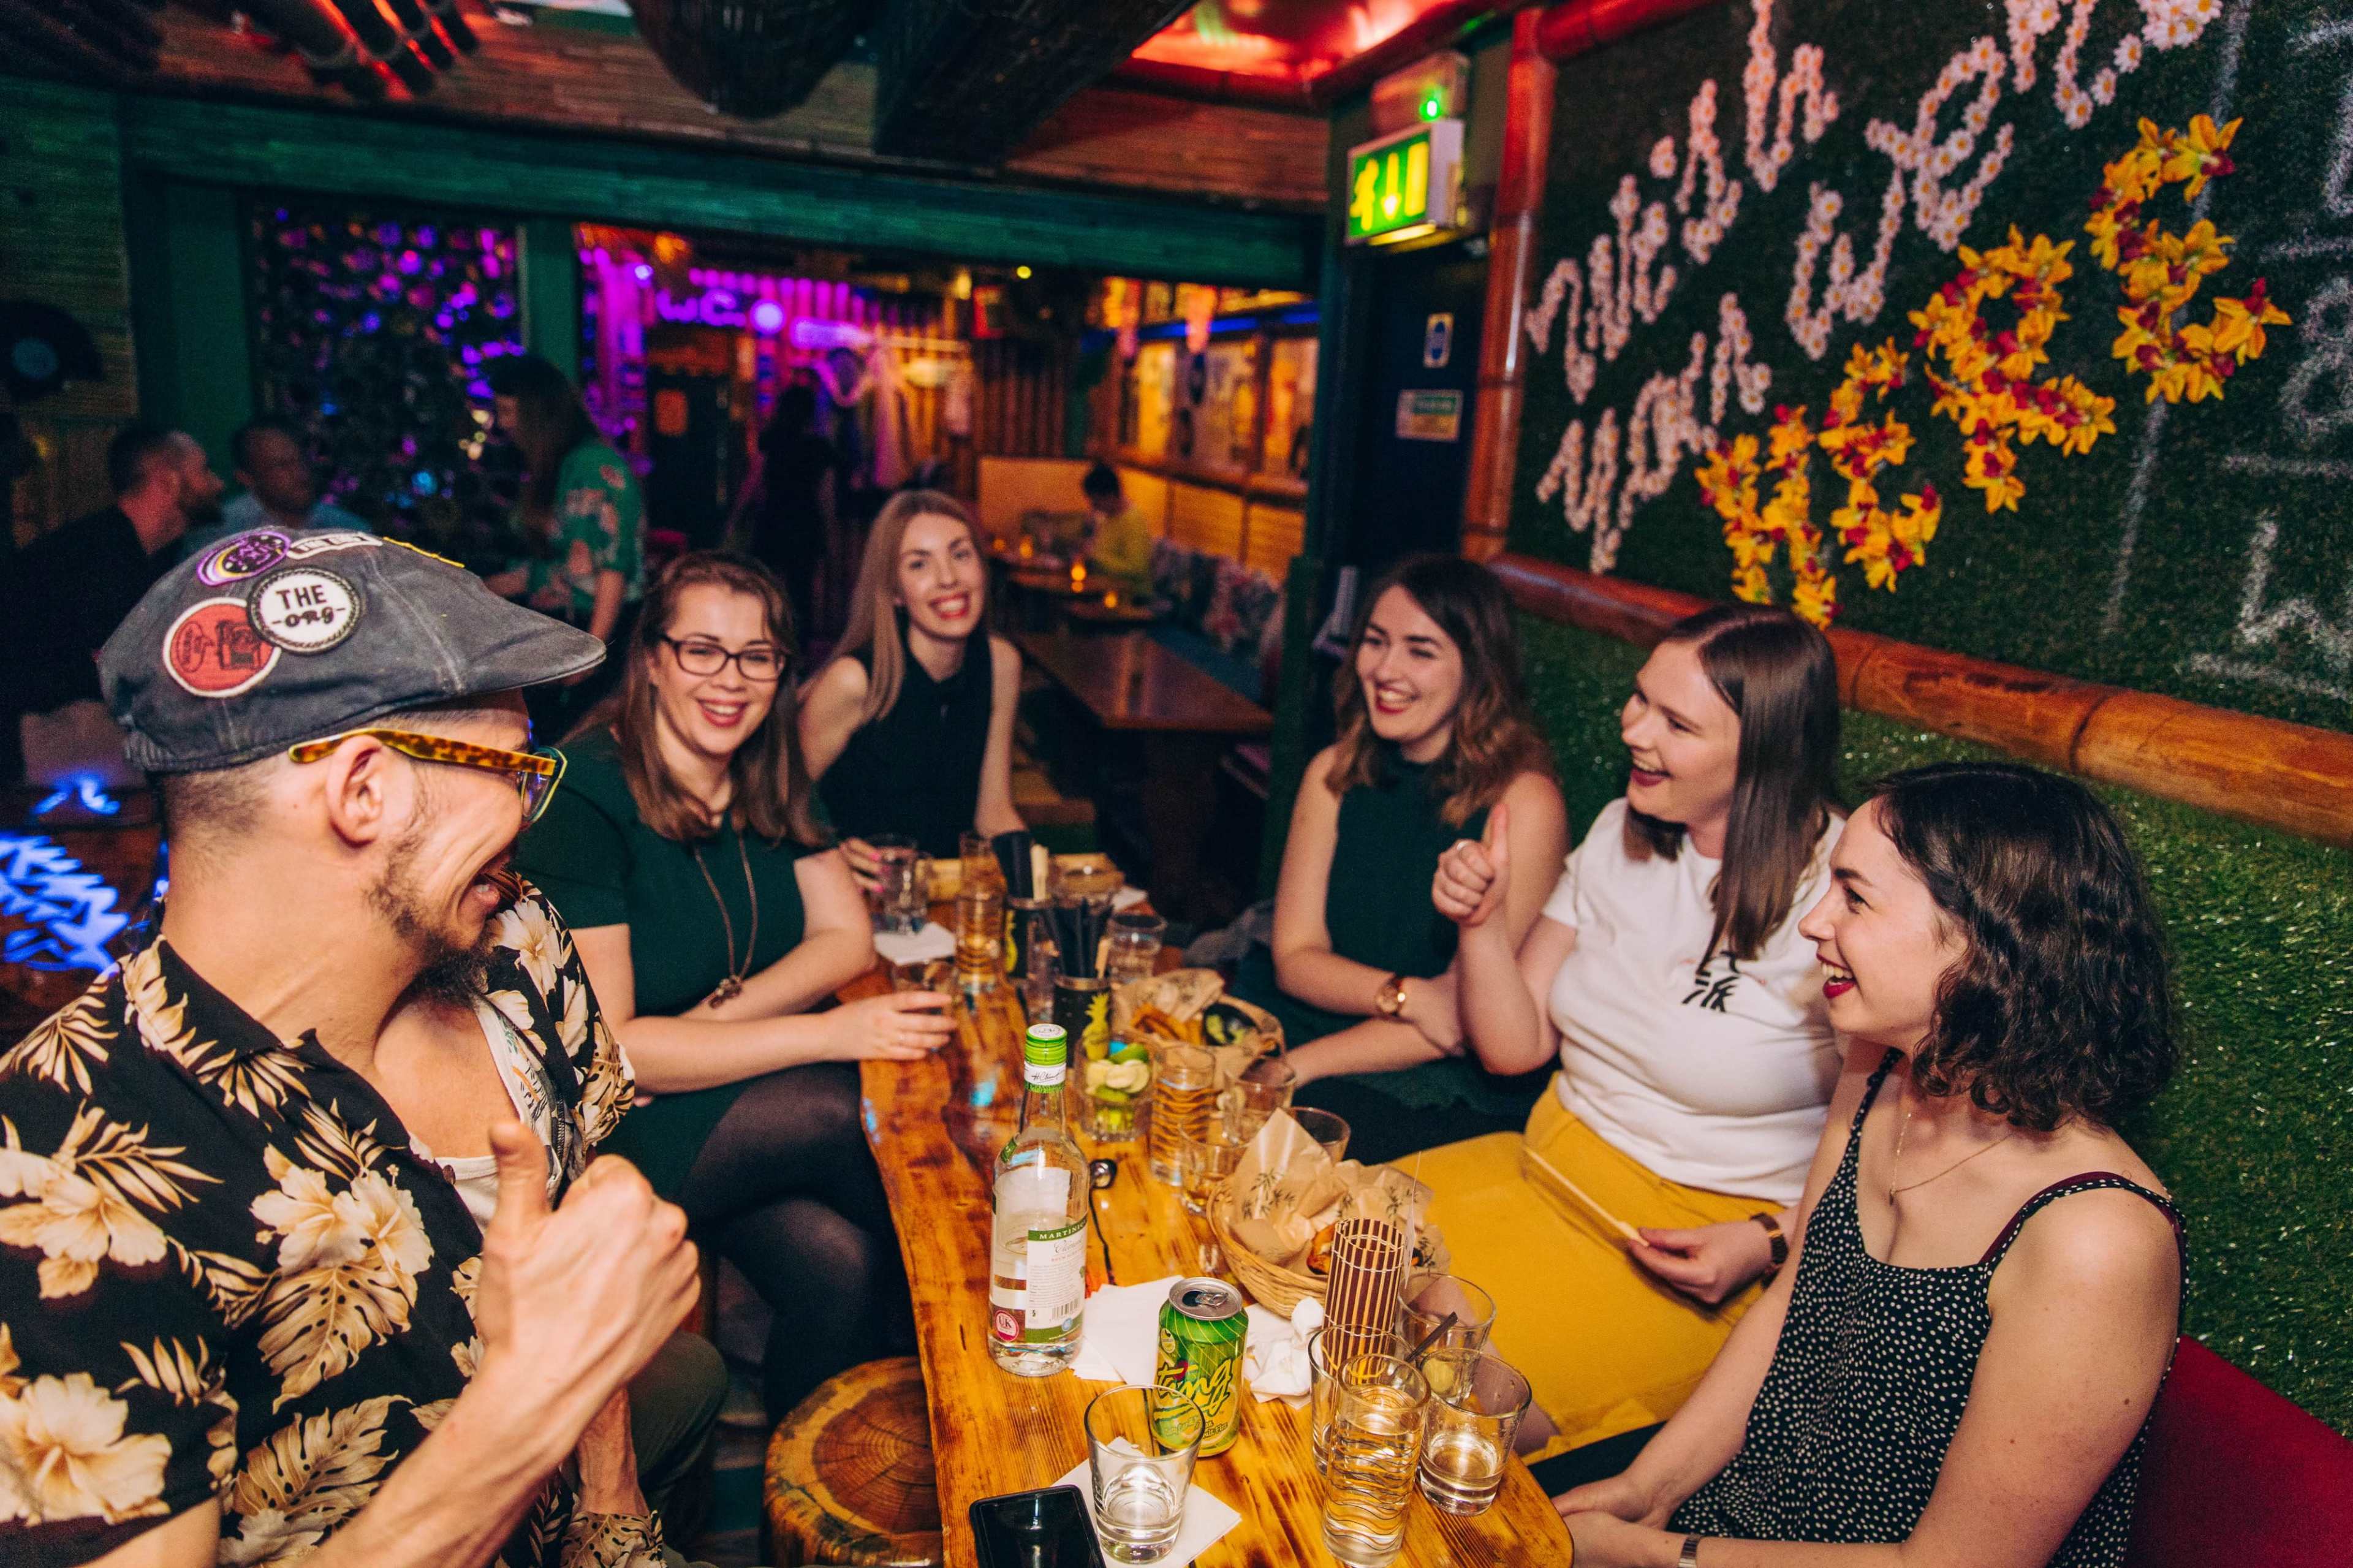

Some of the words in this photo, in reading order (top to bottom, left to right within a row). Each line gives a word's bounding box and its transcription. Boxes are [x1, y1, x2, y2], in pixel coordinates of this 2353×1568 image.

[1696, 114, 2292, 630] HERE
[276, 584, 327, 610] THE
[1039, 1217, 1087, 1240] MARTINI
[999, 1316, 1012, 1328] UK
